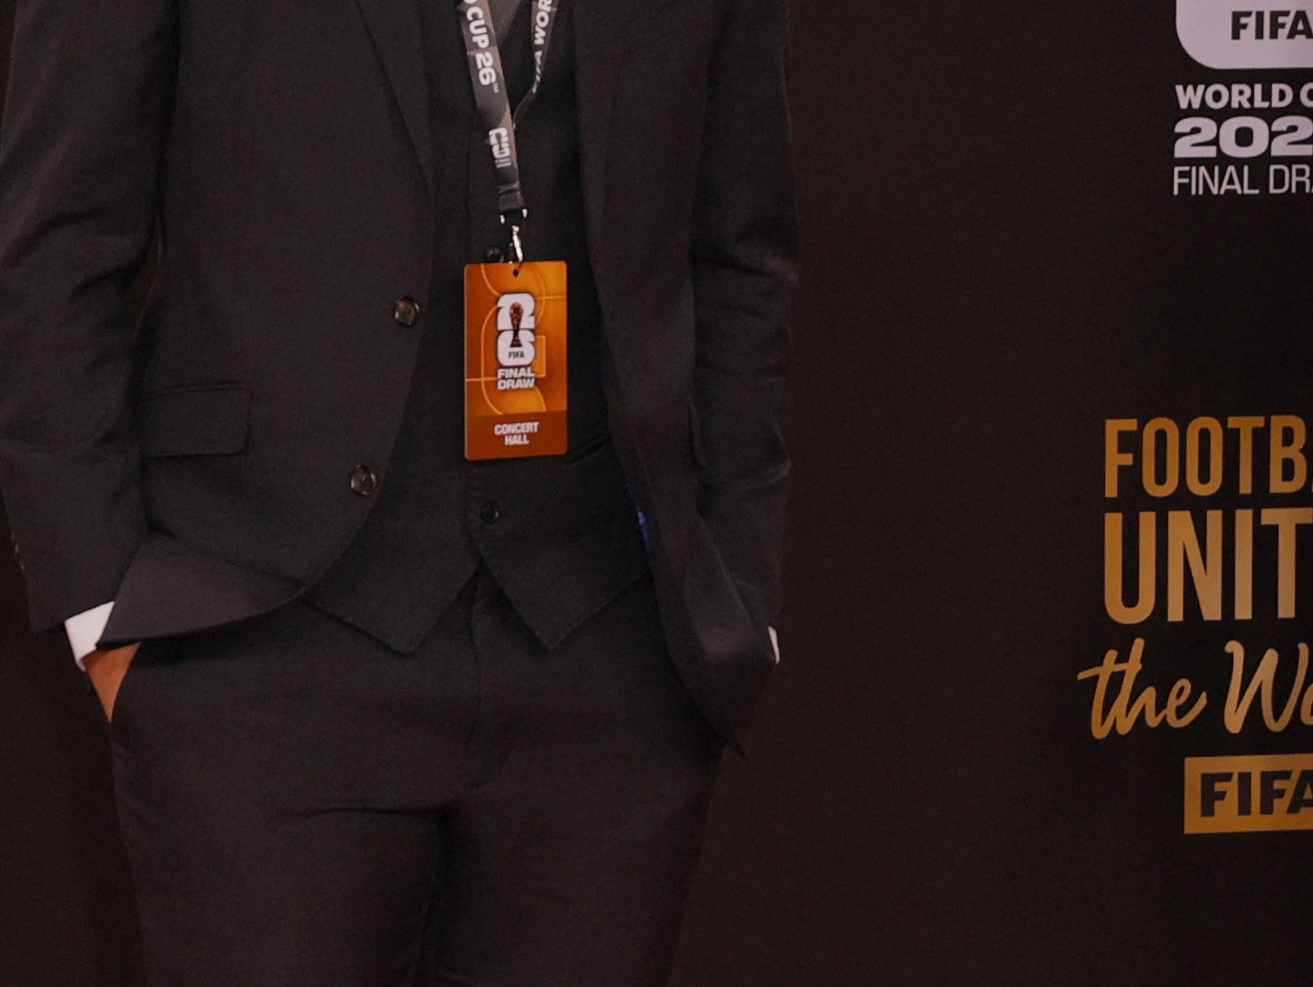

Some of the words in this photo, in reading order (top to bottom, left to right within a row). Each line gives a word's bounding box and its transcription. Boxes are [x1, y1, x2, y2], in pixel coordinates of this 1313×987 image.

[467, 7, 489, 48] CUP
[1232, 10, 1313, 40] FIFA
[1176, 84, 1293, 109] WORLD
[1174, 116, 1313, 158] 202
[1174, 165, 1259, 195] FINAL
[1269, 164, 1313, 194] DR
[508, 350, 525, 359] FIFA
[498, 366, 535, 380] FINAL
[498, 377, 536, 390] DRAW
[494, 421, 540, 436] CONCERT
[504, 434, 530, 446] HALL
[1105, 416, 1313, 497] FOOTB
[1105, 508, 1313, 624] UNIT
[1077, 638, 1207, 739] the
